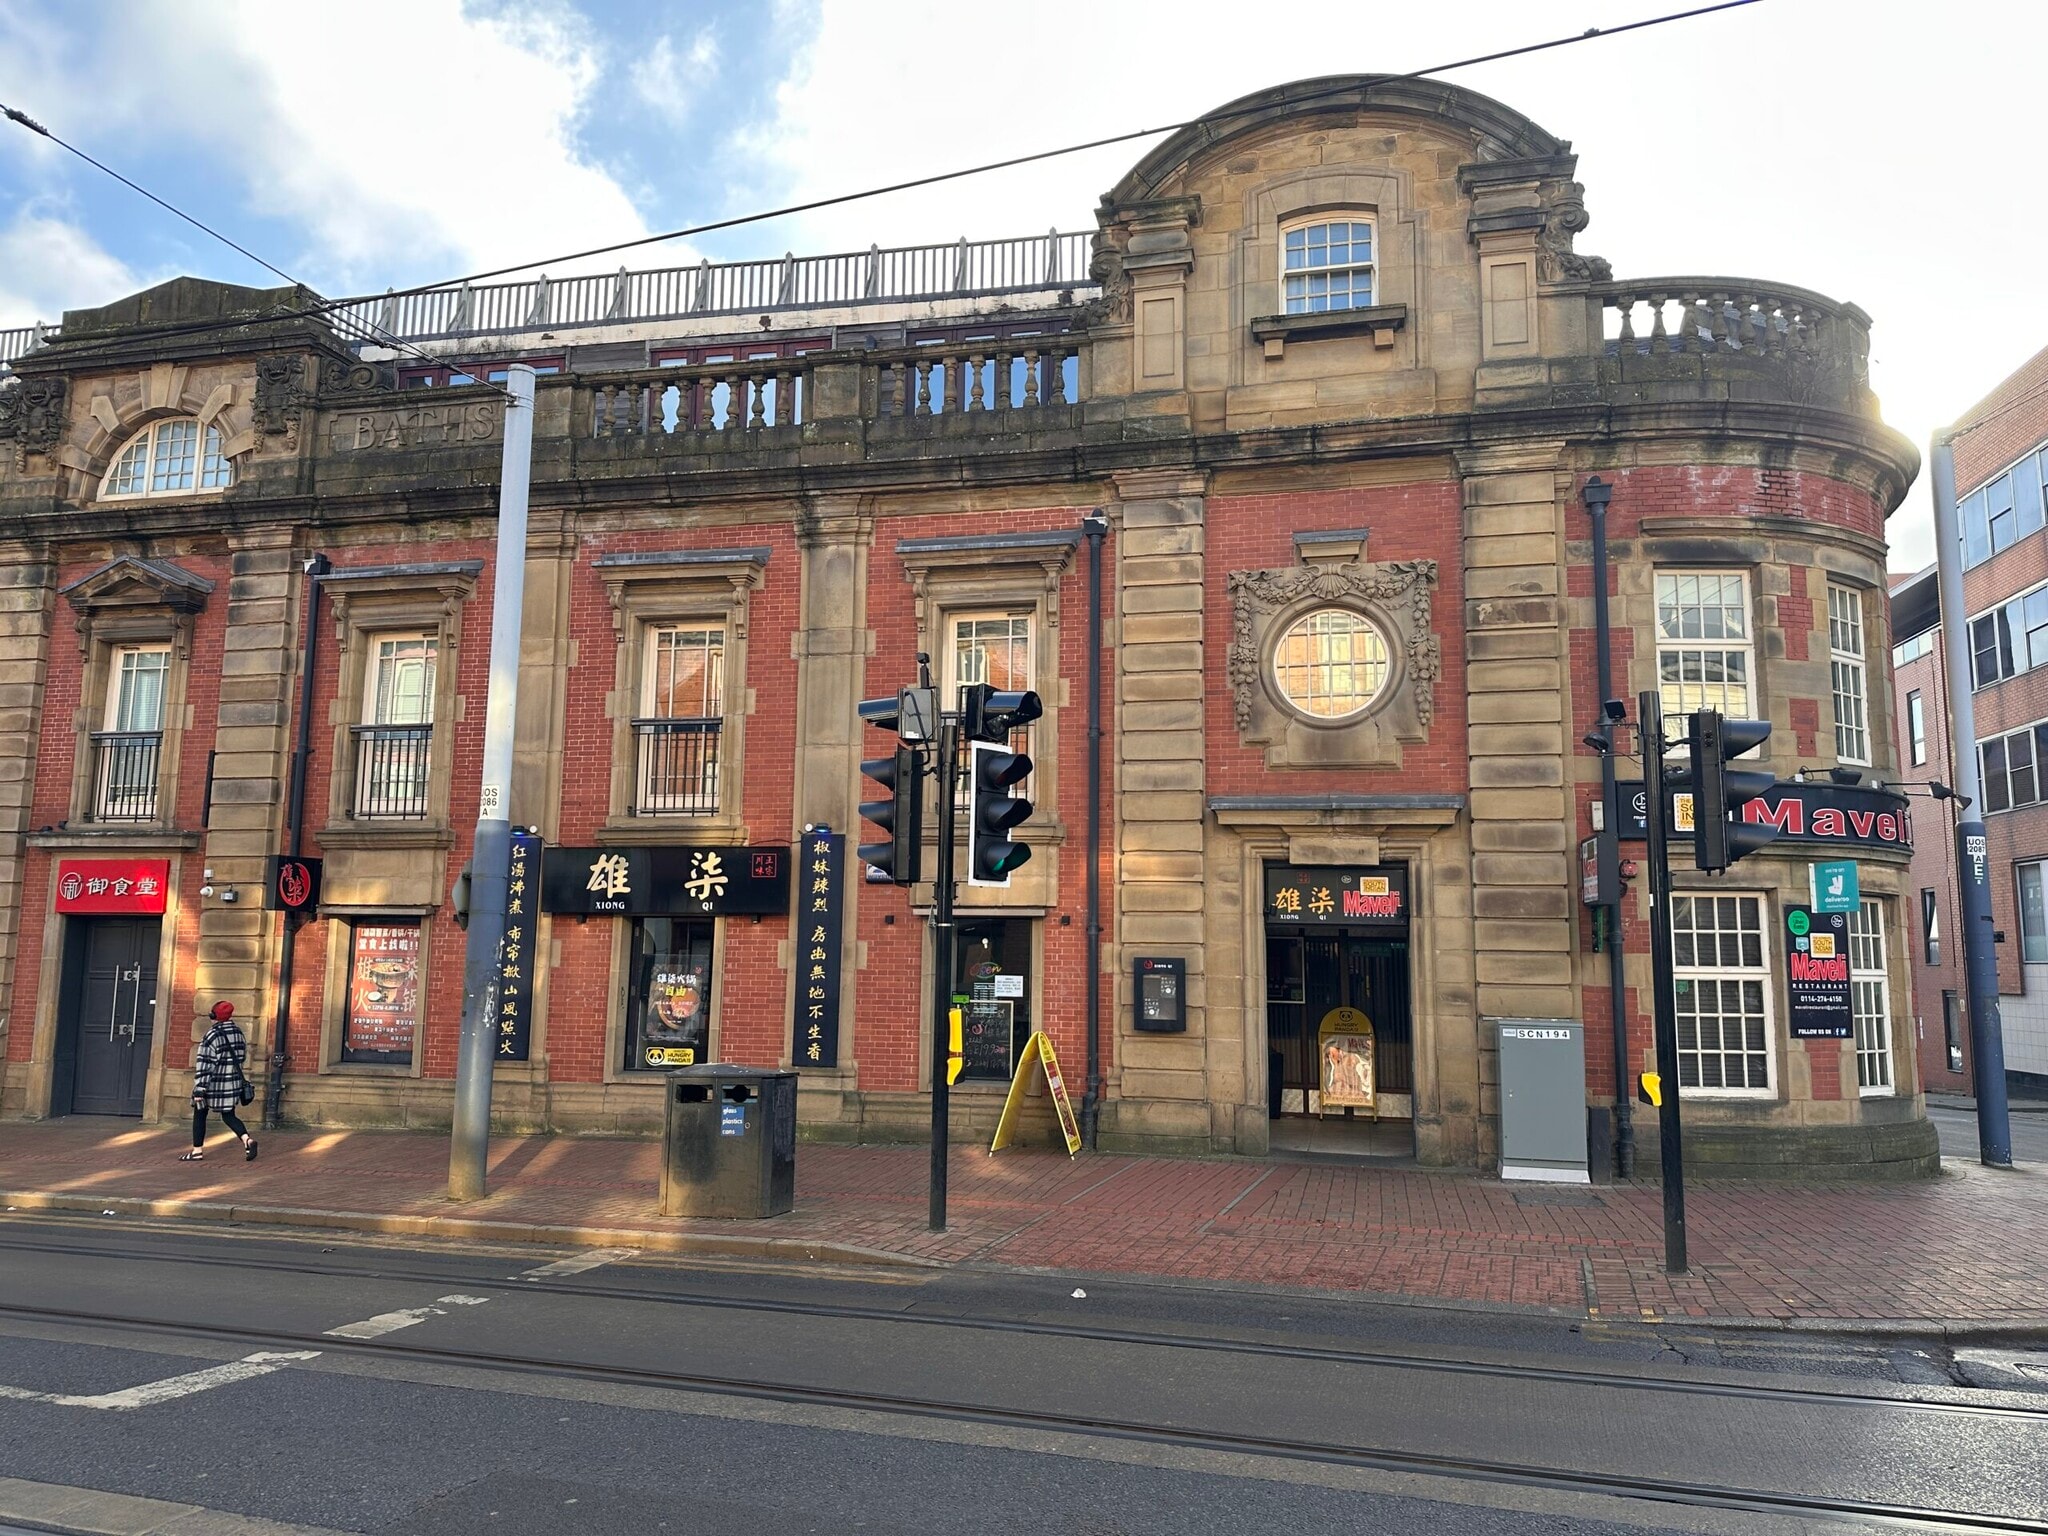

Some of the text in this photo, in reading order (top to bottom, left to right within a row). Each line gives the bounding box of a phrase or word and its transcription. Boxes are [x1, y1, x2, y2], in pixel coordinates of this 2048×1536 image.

[352, 404, 495, 450] BATHS
[481, 788, 498, 797] OS
[480, 798, 497, 807] 086
[482, 808, 489, 816] A
[1974, 864, 1984, 876] E
[86, 877, 159, 896] 御食堂
[595, 901, 714, 911] XIONG QI
[1343, 890, 1400, 914] Maveli
[1791, 953, 1847, 981] Maveli
[722, 1118, 743, 1126] plastics
